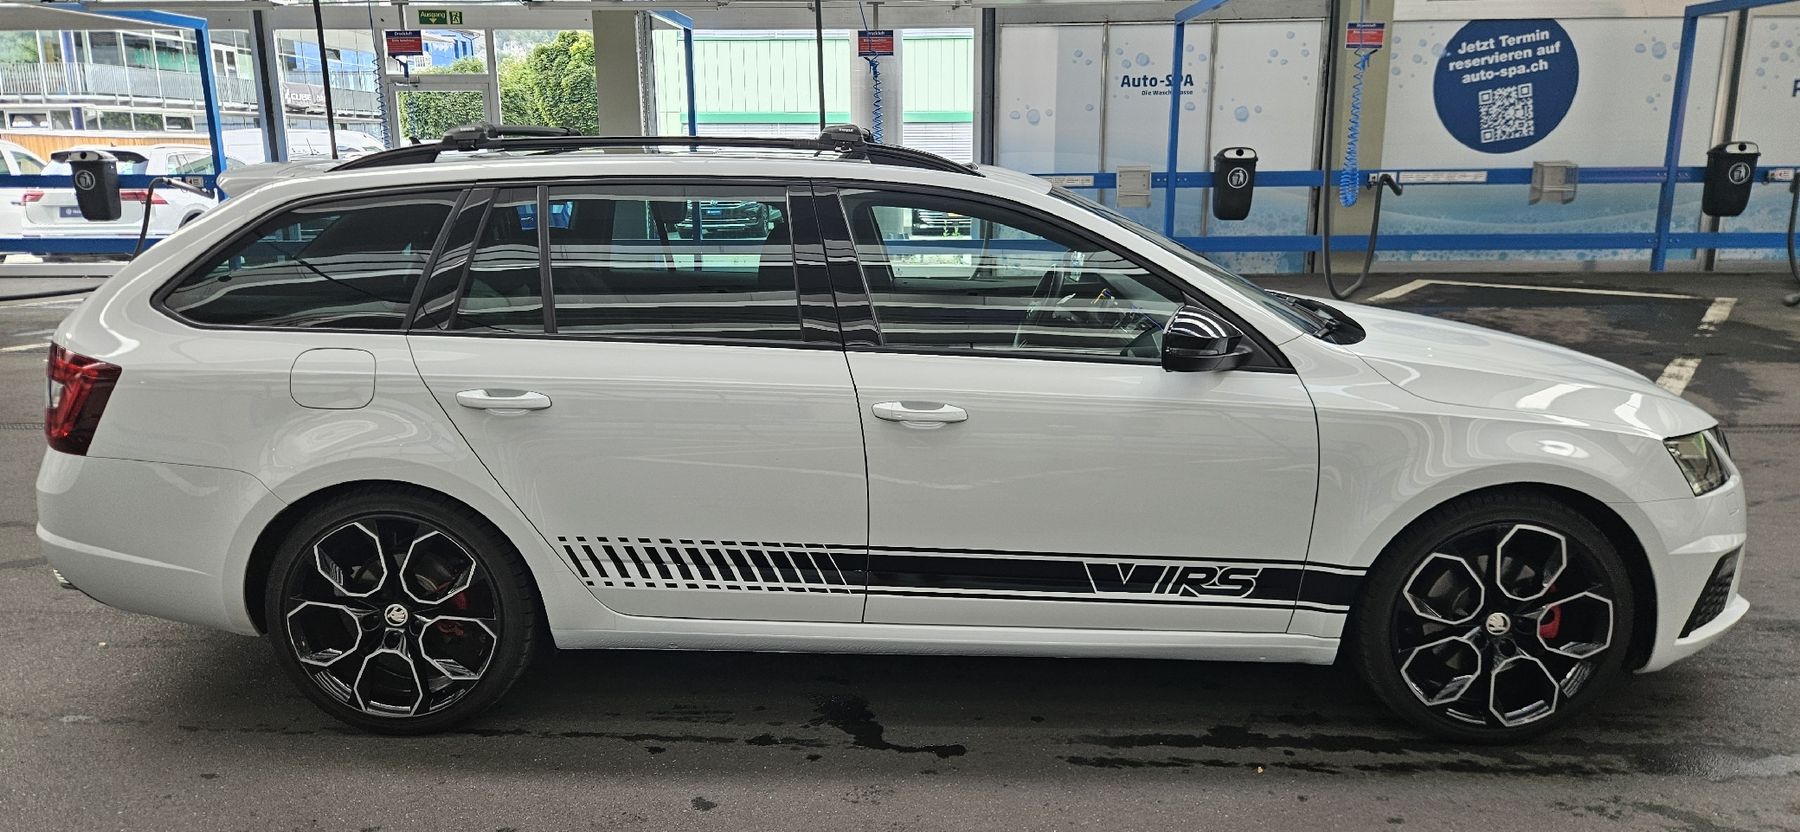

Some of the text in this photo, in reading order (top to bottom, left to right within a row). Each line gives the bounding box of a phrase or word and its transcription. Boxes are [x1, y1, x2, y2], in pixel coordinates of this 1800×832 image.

[1457, 29, 1550, 54] Jetzt Termin
[1448, 41, 1561, 71] reservieren auf
[1120, 74, 1194, 88] Auto-SA
[1461, 59, 1549, 84] auto-spa.ch
